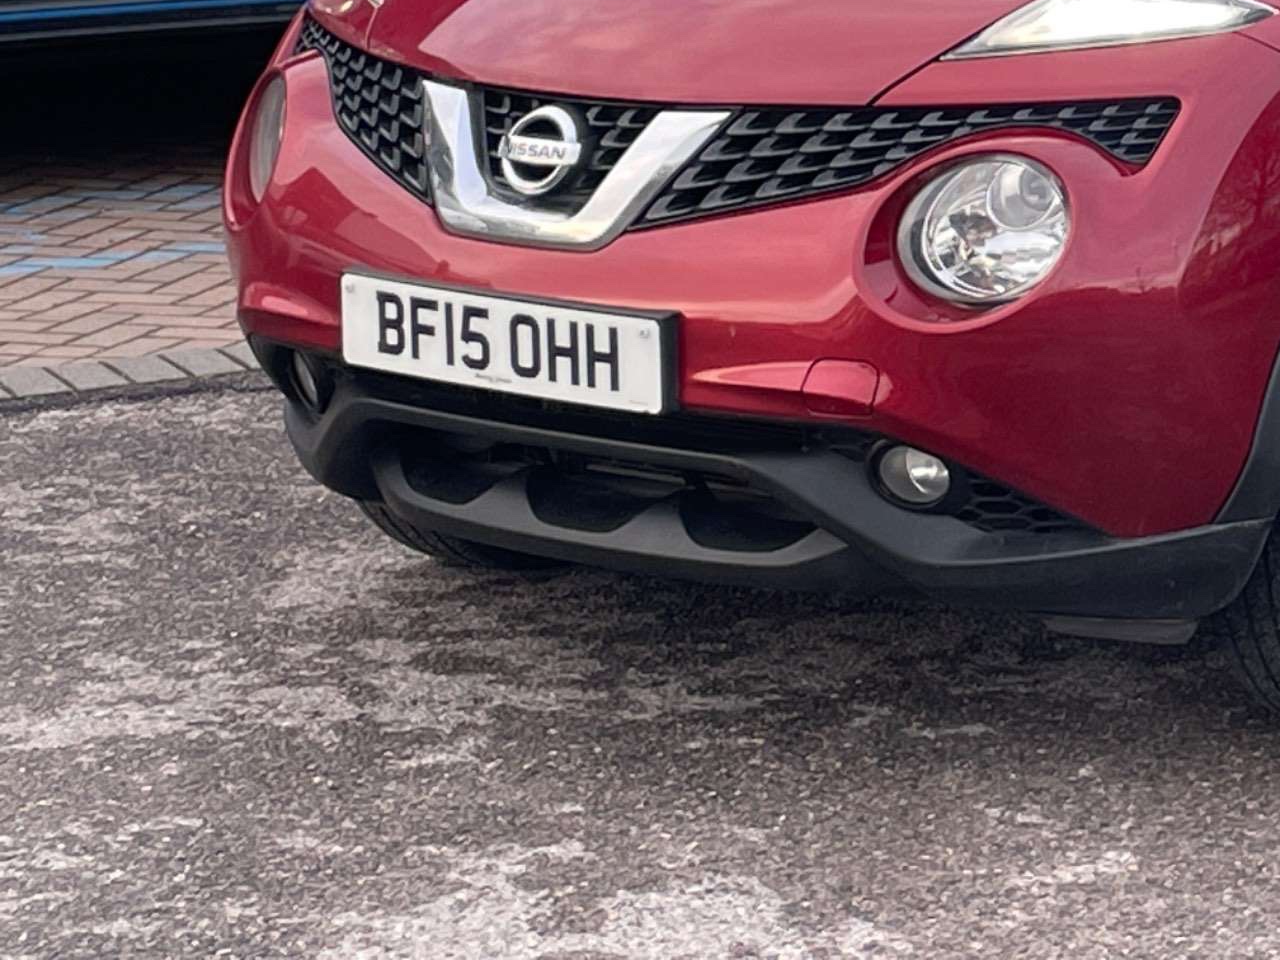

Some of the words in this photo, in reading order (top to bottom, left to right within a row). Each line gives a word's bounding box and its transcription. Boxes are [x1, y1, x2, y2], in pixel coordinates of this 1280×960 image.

[504, 140, 567, 159] NISSAN
[375, 289, 491, 371] BF15
[508, 312, 621, 392] OHH
